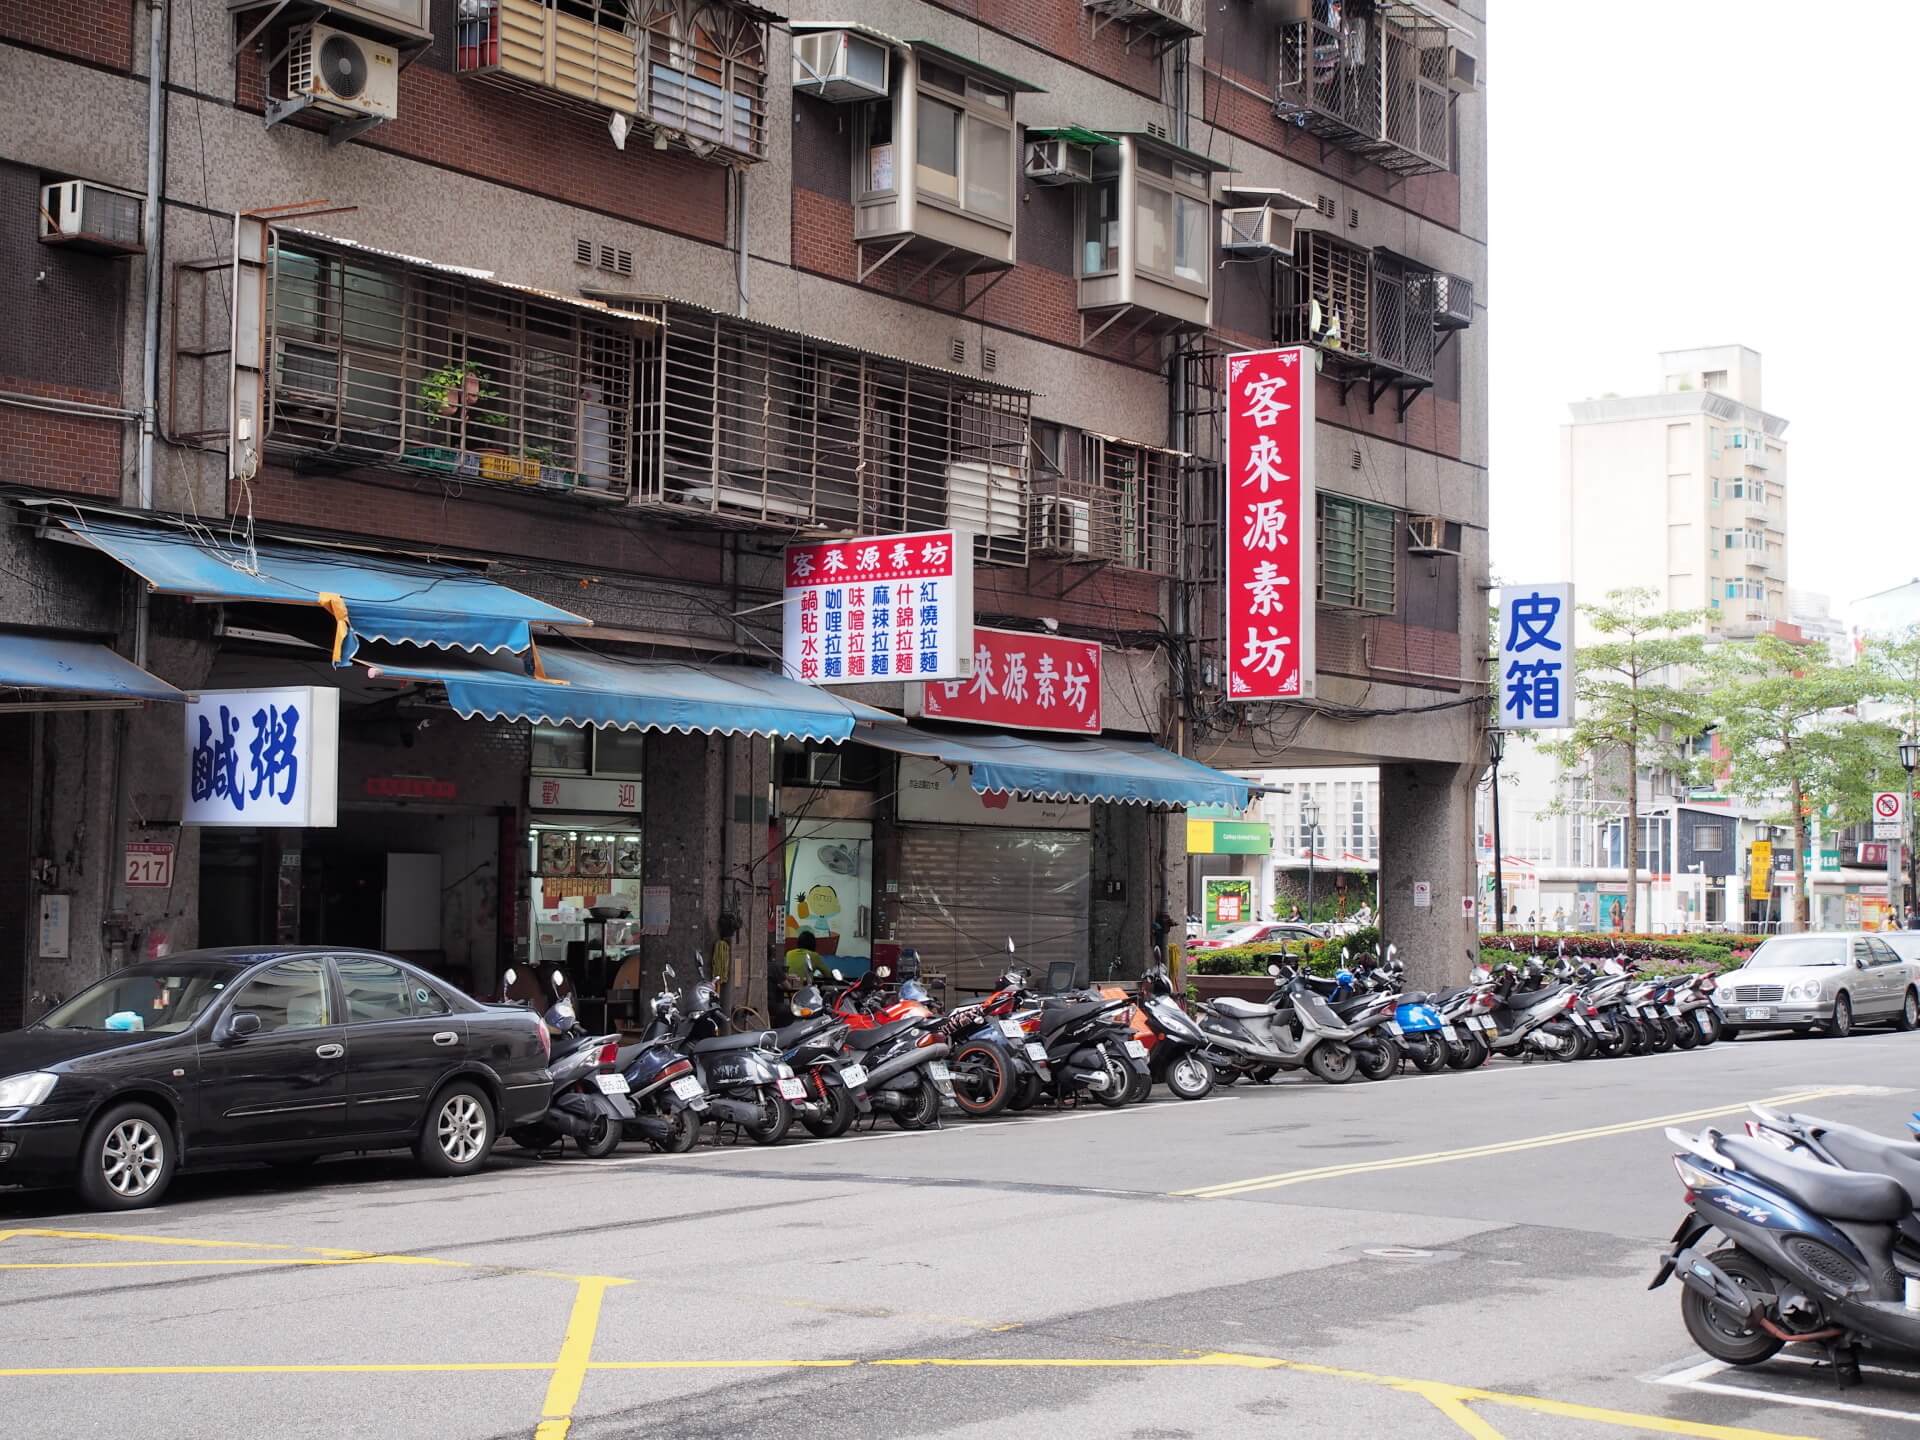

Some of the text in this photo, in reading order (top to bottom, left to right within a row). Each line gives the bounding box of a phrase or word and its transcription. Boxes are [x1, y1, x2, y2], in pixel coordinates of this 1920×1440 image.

[791, 541, 949, 578] 客來源素坊
[1241, 372, 1292, 677] 客來源素坊
[800, 590, 818, 679] 鍋貼水餃
[824, 588, 842, 678] 咖哩拉麵
[871, 584, 890, 675] 麻辣拉麵
[896, 583, 914, 674] 什錦拉麵
[920, 581, 938, 673] 紅燒拉麵
[1505, 592, 1562, 720] 皮箱
[192, 703, 300, 811] 鹹粥
[129, 860, 164, 881] 217
